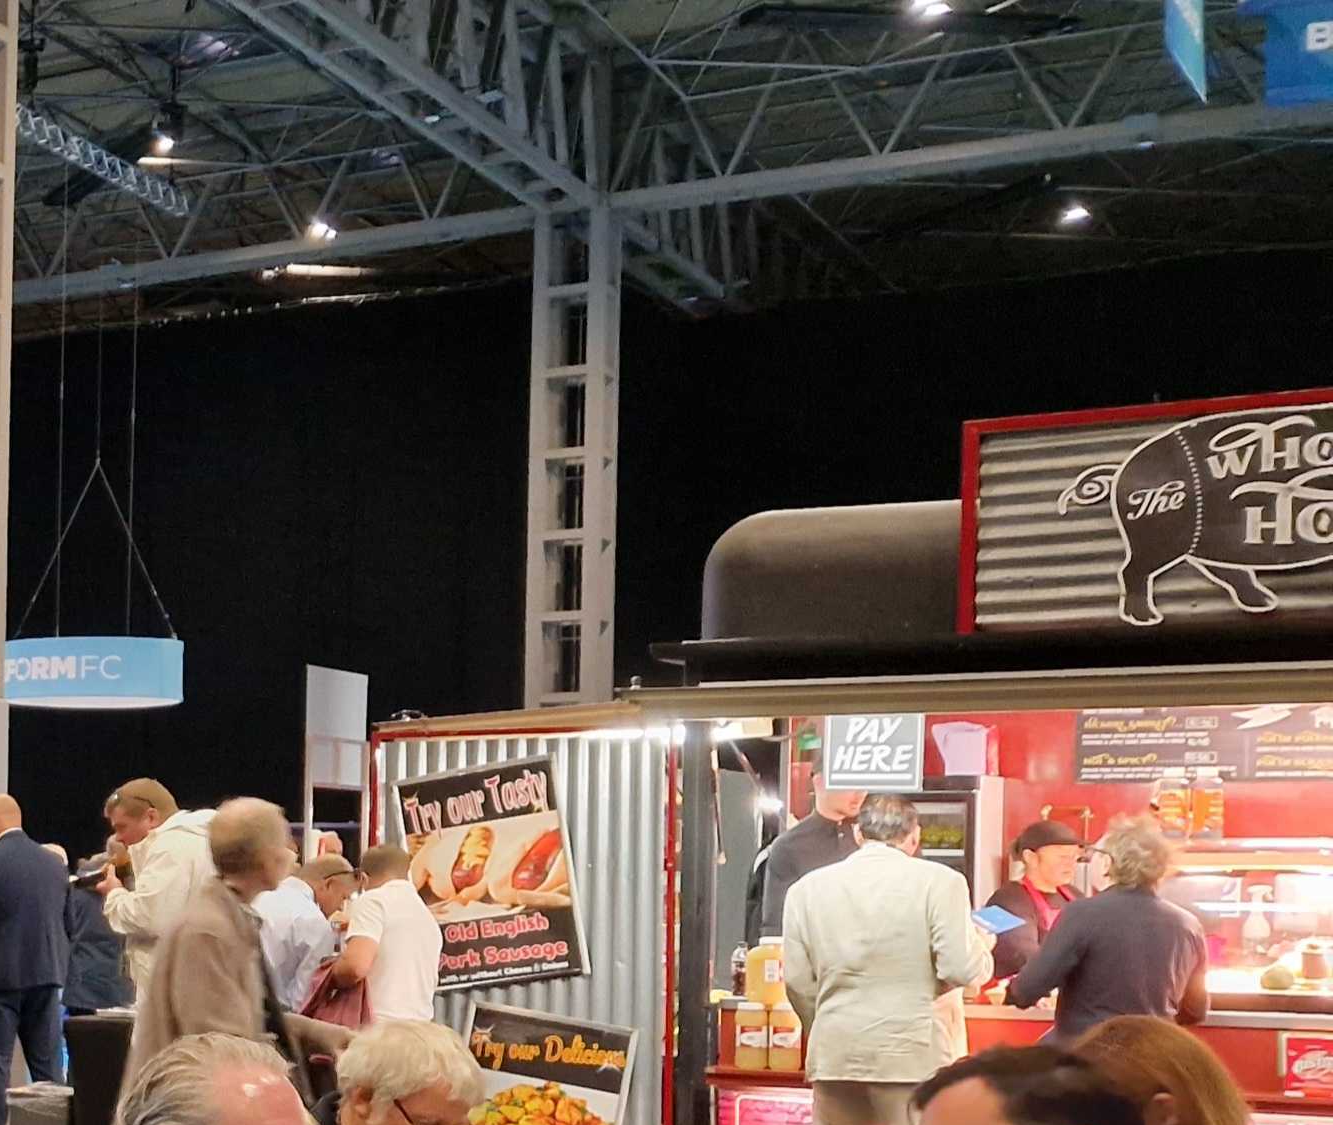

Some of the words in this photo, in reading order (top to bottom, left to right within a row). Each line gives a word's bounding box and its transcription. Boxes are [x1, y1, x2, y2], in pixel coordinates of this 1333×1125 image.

[1127, 480, 1186, 520] The
[844, 716, 903, 744] PAY
[832, 744, 914, 772] HERE
[404, 799, 443, 840] Try
[446, 789, 485, 824] our
[484, 768, 550, 815] Tasty
[445, 920, 479, 943] Old
[480, 912, 549, 939] English
[484, 941, 568, 965] Sausage
[471, 1031, 505, 1070] Try
[509, 1042, 540, 1061] our
[544, 1034, 626, 1067] Delicious
